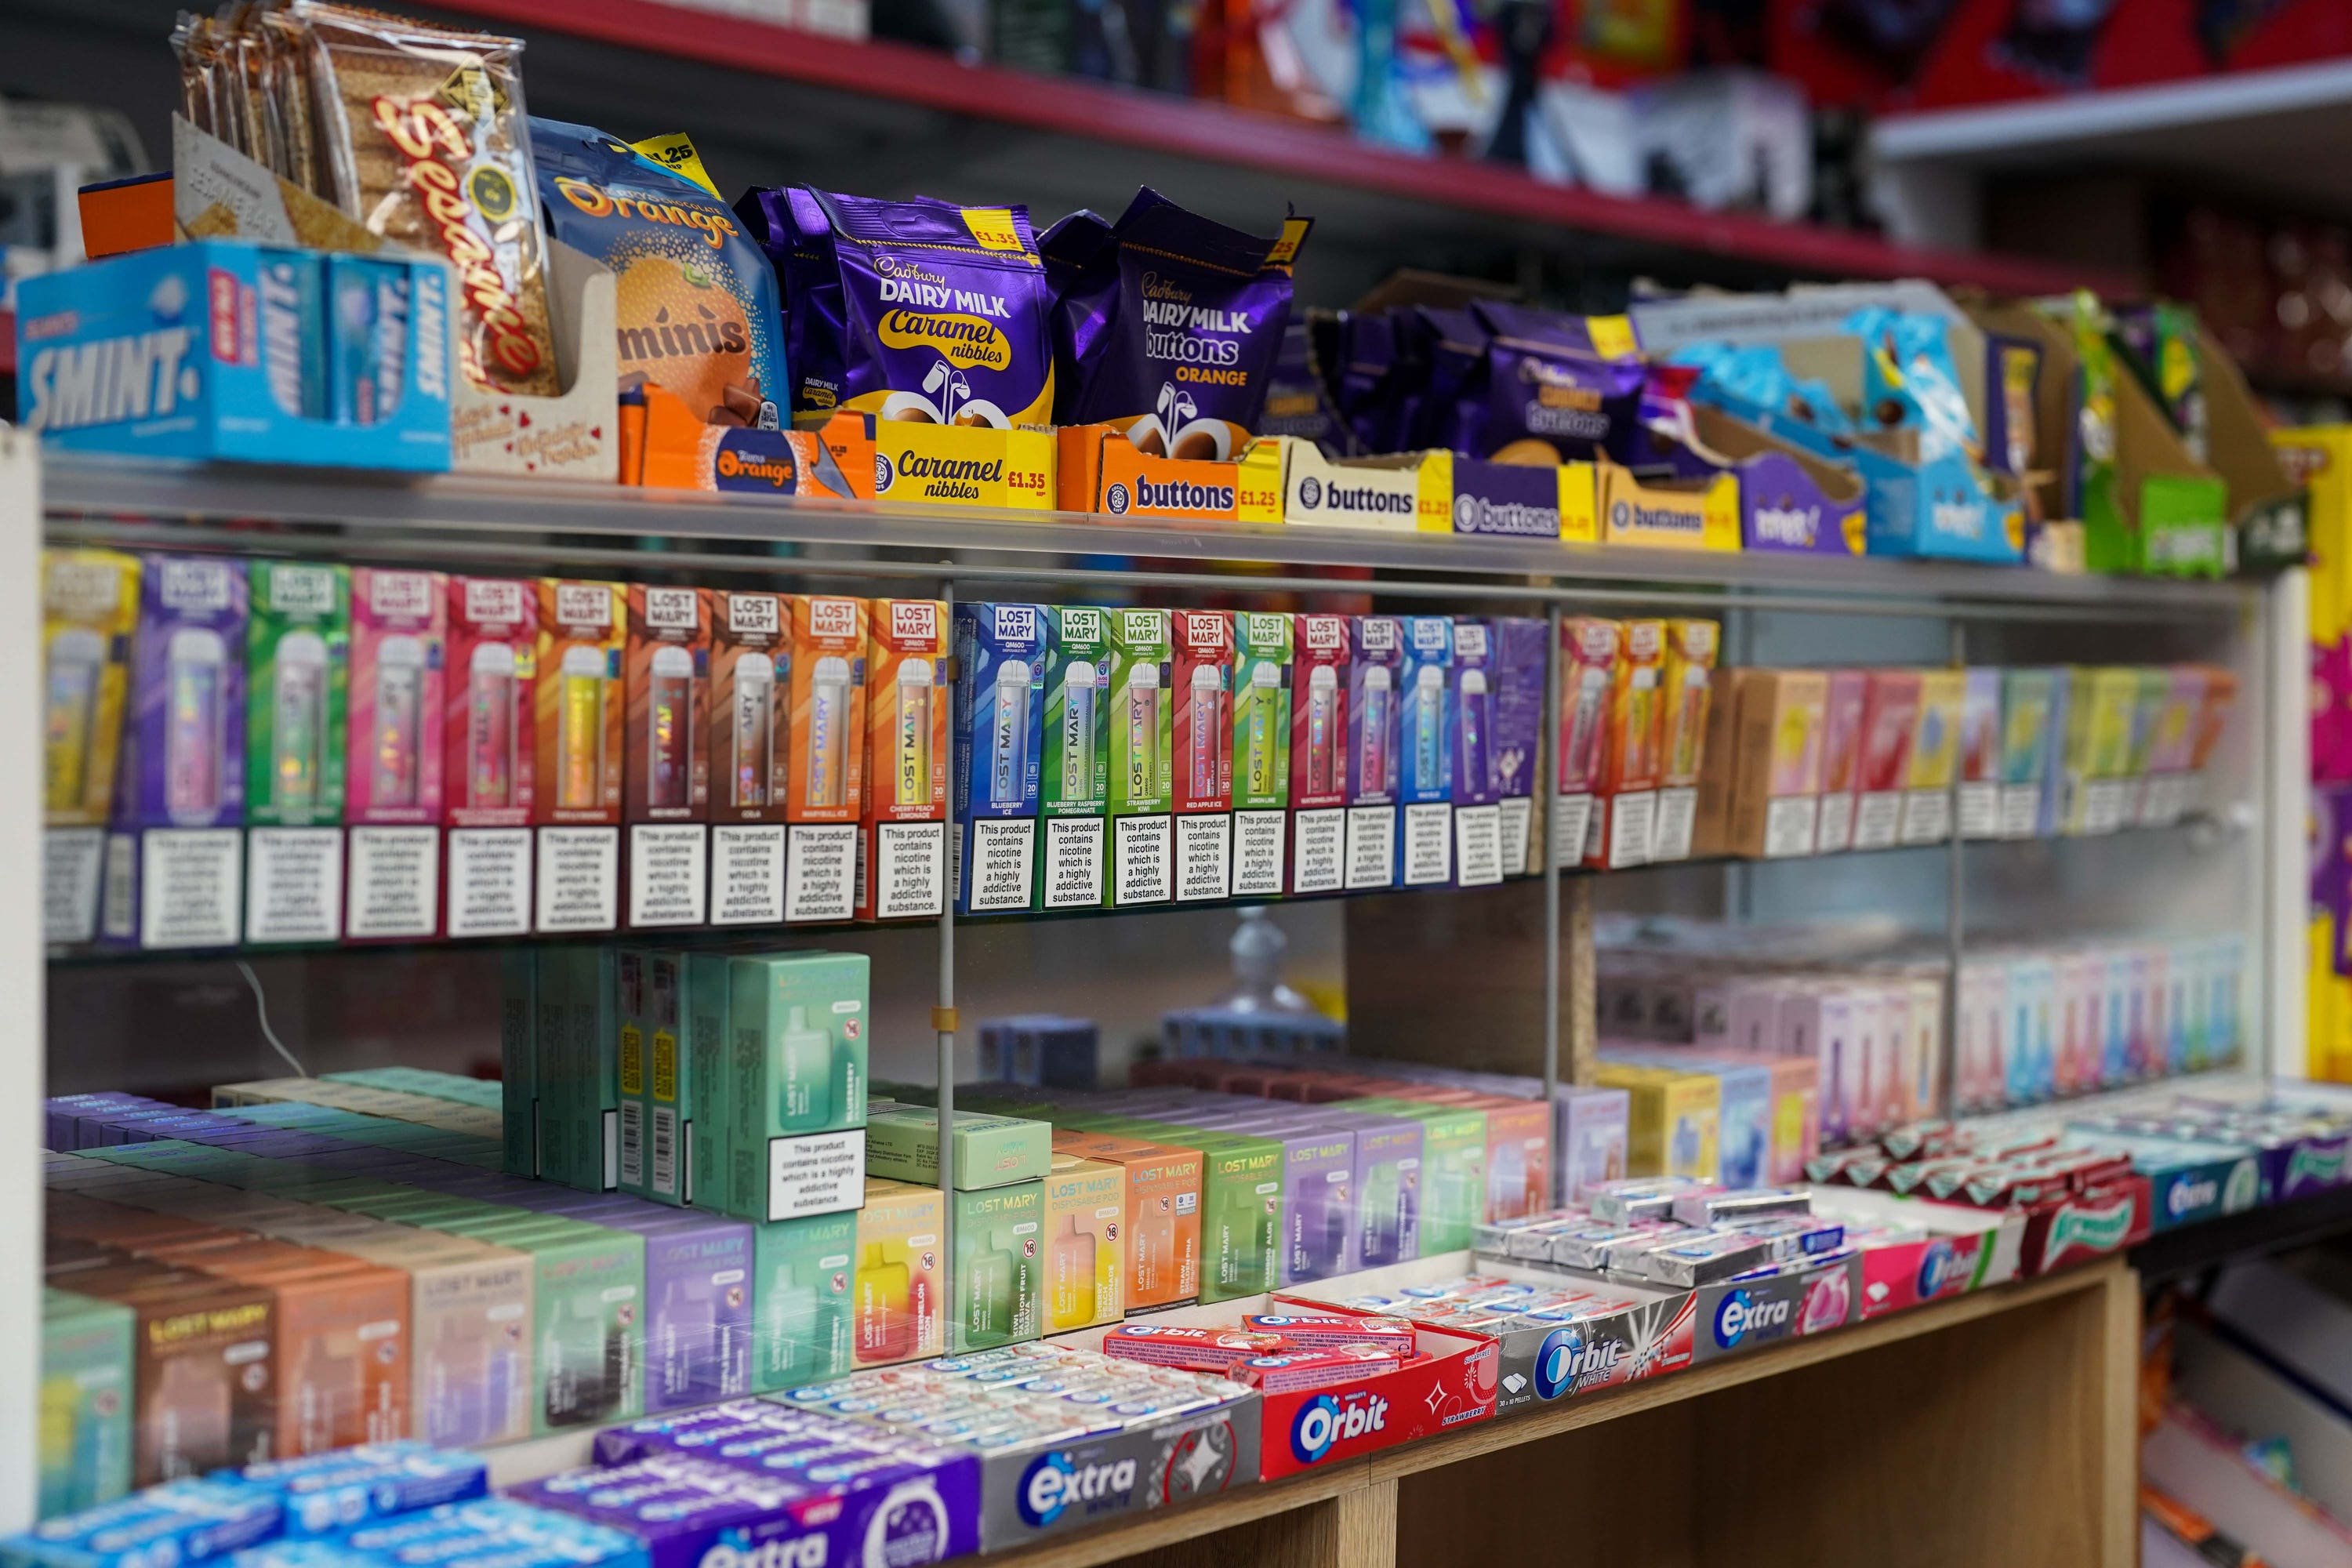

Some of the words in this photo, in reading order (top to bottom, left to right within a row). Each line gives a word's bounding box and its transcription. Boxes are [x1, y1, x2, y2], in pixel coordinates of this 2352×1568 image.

[554, 176, 739, 249] Orange
[975, 230, 1018, 245] £1.35
[873, 256, 946, 289] Cadbury
[1142, 271, 1192, 304] Cadbury
[880, 278, 951, 309] DAIRY
[955, 289, 1011, 318] MILK
[1143, 299, 1192, 327] DAIRY
[1189, 307, 1252, 334] MILK
[890, 308, 996, 344] Caramel
[617, 306, 747, 361] minis
[1146, 325, 1239, 365] buttons
[950, 343, 1002, 363] nibbles
[28, 328, 191, 433] SMINT
[1176, 366, 1248, 386] ORANGE
[805, 377, 822, 388] DAIRY
[823, 380, 839, 391] MILK
[803, 387, 834, 400] Caramel
[718, 450, 793, 487] Orange
[898, 449, 1004, 482] Caramel
[1008, 471, 1045, 488] £1.35
[924, 481, 979, 499] nibbles
[1136, 474, 1234, 510] buttons
[1240, 491, 1275, 506] £1.25
[1327, 481, 1413, 514] buttons
[1481, 496, 1559, 535] buttons
[815, 605, 852, 618] LOST
[896, 607, 931, 620] LOST
[999, 610, 1031, 623] LOST
[1065, 612, 1097, 626] LOST
[1127, 615, 1158, 627] LOST
[1191, 618, 1221, 630] LOST
[1253, 618, 1280, 630] LOST
[815, 621, 852, 633] MARY
[896, 622, 931, 635] MARY
[999, 625, 1031, 637] MARY
[1065, 626, 1097, 640] MARY
[1309, 621, 1336, 633] LOST
[1127, 629, 1158, 641] MARY
[1191, 631, 1221, 644] MARY
[1253, 630, 1280, 643] MARY
[1309, 635, 1337, 645] MARY
[1134, 698, 1142, 746] MARY
[1134, 751, 1142, 797] LOST
[980, 825, 998, 834] This
[1000, 825, 1031, 836] product
[1052, 823, 1069, 833] This
[1071, 822, 1100, 834] product
[1120, 822, 1137, 832] This
[1138, 820, 1167, 833] product
[1181, 819, 1198, 829] This
[1199, 818, 1226, 831] product
[884, 829, 906, 839] This
[909, 828, 940, 840] product
[1058, 834, 1093, 844] contains
[1127, 832, 1160, 843] contains
[1188, 830, 1220, 840] contains
[893, 840, 932, 851] contains
[987, 837, 1023, 846] contains
[1189, 841, 1219, 851] nicotine
[988, 848, 1022, 858] nicotine
[1059, 846, 1092, 856] nicotine
[1128, 844, 1160, 854] nicotine
[895, 853, 931, 862] nicotine
[1058, 858, 1082, 867] which
[1085, 857, 1092, 866] is
[1127, 855, 1151, 866] which
[1153, 855, 1160, 863] is
[1188, 852, 1211, 862] which
[1213, 852, 1219, 861] is
[894, 865, 920, 875] which
[923, 864, 931, 874] is
[986, 860, 1011, 869] which
[1196, 862, 1218, 875] highly
[994, 871, 1020, 883] highly
[1066, 869, 1091, 880] highly
[1135, 866, 1160, 878] highly
[902, 877, 930, 889] highly
[1055, 880, 1093, 891] addictive
[1126, 877, 1162, 888] addictive
[1186, 874, 1220, 885] addictive
[983, 883, 1022, 893] addictive
[1123, 888, 1166, 899] substance.
[1184, 884, 1224, 896] substance.
[891, 890, 932, 900] addictive
[979, 895, 1025, 905] substance.
[1053, 892, 1097, 902] substance.
[887, 902, 937, 913] substance.
[1290, 1148, 1317, 1162] LOST
[1319, 1143, 1349, 1157] MARY
[1218, 1159, 1247, 1174] LOST
[1249, 1154, 1279, 1169] MARY
[1133, 1168, 1163, 1183] LOST
[1166, 1162, 1197, 1177] MARY
[1051, 1182, 1083, 1199] LOST
[1087, 1176, 1119, 1192] MARY
[967, 1198, 1000, 1214] LOST
[1004, 1193, 1037, 1210] MARY
[1258, 1316, 1343, 1327] Orbit
[1721, 1300, 1790, 1337] extra
[1125, 1325, 1207, 1338] Orbit
[1464, 1348, 1491, 1365] SUGARFREE
[1546, 1338, 1622, 1385] Orbit
[1577, 1370, 1611, 1388] WHITE
[1514, 1395, 1531, 1404] PELLETS
[1300, 1394, 1388, 1451] Orbit
[1442, 1406, 1486, 1426] STRAWBERRY
[1028, 1457, 1137, 1514] extra
[699, 1531, 828, 1568] extra
